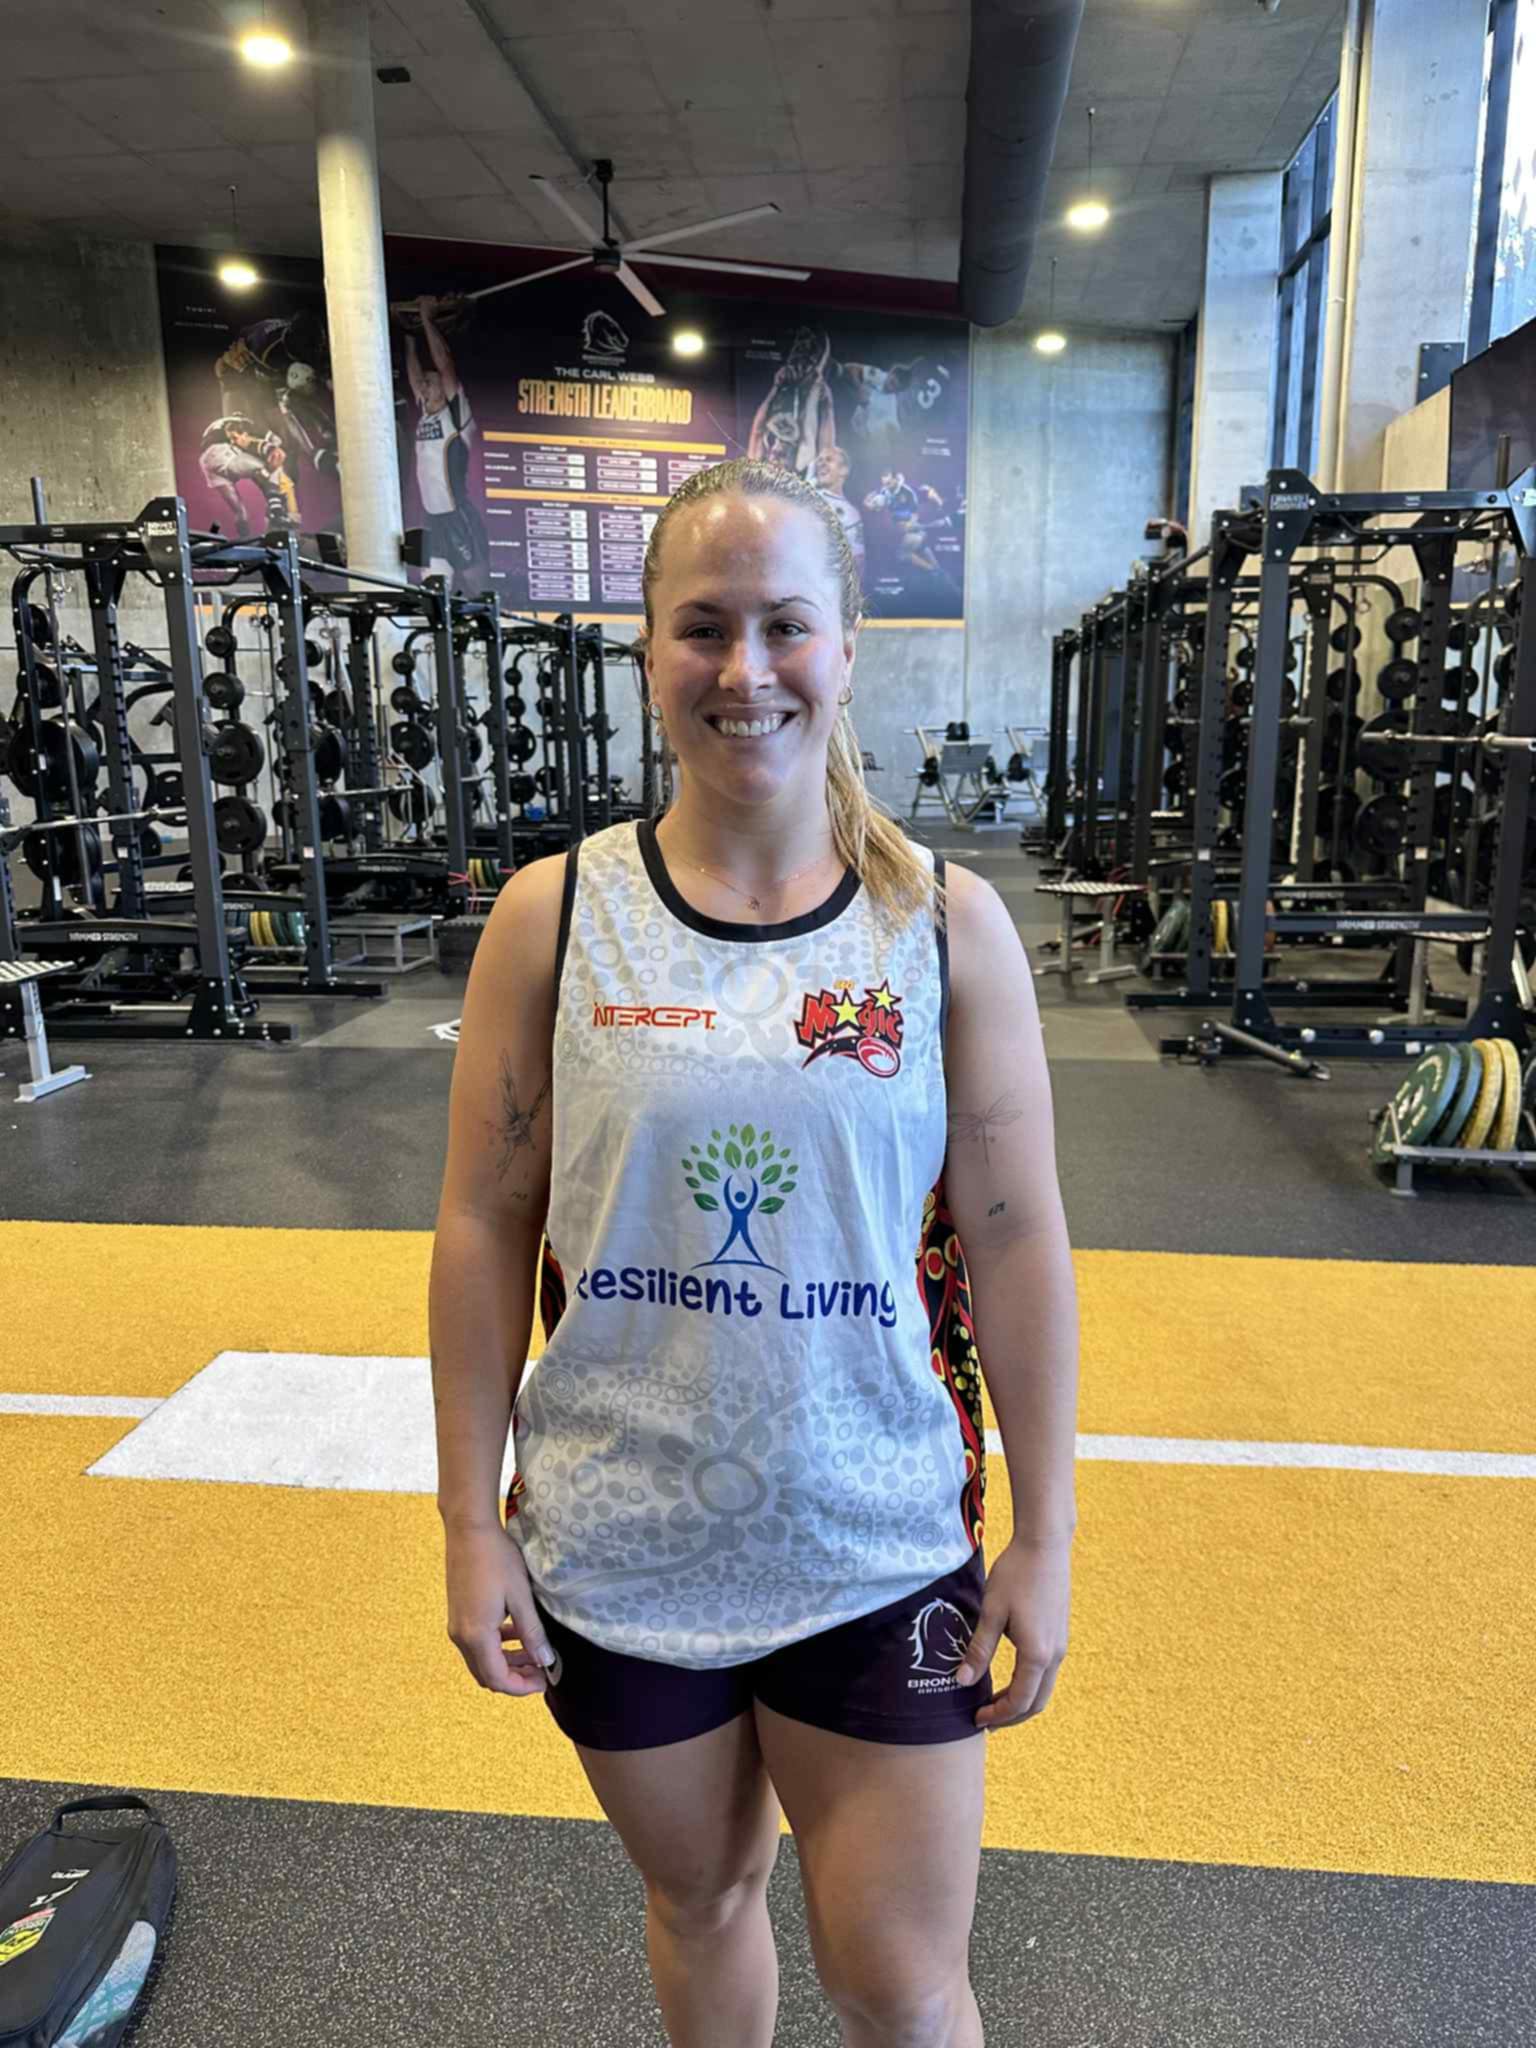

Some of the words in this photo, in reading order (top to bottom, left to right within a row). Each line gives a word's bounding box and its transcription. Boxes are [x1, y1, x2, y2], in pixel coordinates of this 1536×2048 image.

[554, 367, 580, 378] THE
[582, 370, 615, 381] CARL
[617, 372, 655, 384] WEBB
[518, 379, 591, 418] STRENGTH
[593, 384, 692, 425] LEADERBOARD
[780, 1279, 897, 1328] Living
[907, 1676, 960, 1688] BRON
